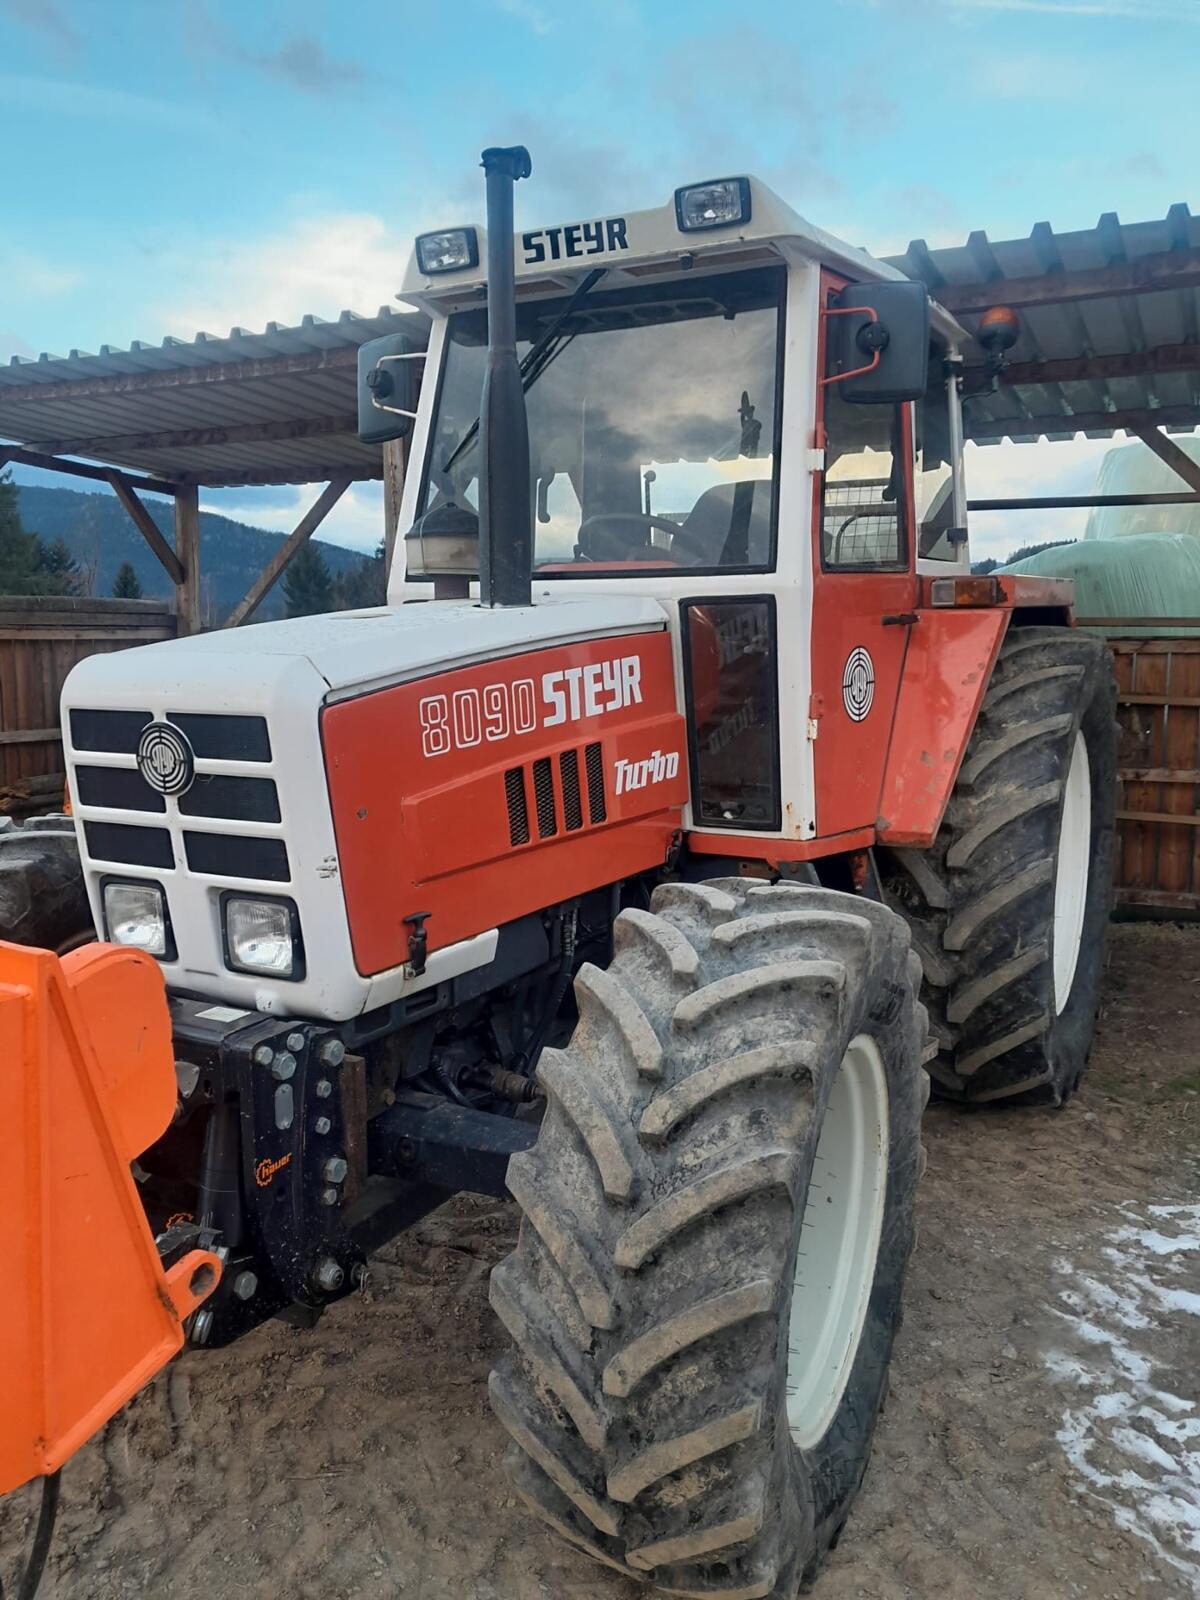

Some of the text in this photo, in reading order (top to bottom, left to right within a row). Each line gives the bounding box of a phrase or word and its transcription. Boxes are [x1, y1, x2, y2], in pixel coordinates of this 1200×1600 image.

[522, 217, 628, 264] STEYR
[419, 678, 537, 758] 8090
[542, 655, 643, 728] STEYR
[614, 750, 679, 796] Turbo
